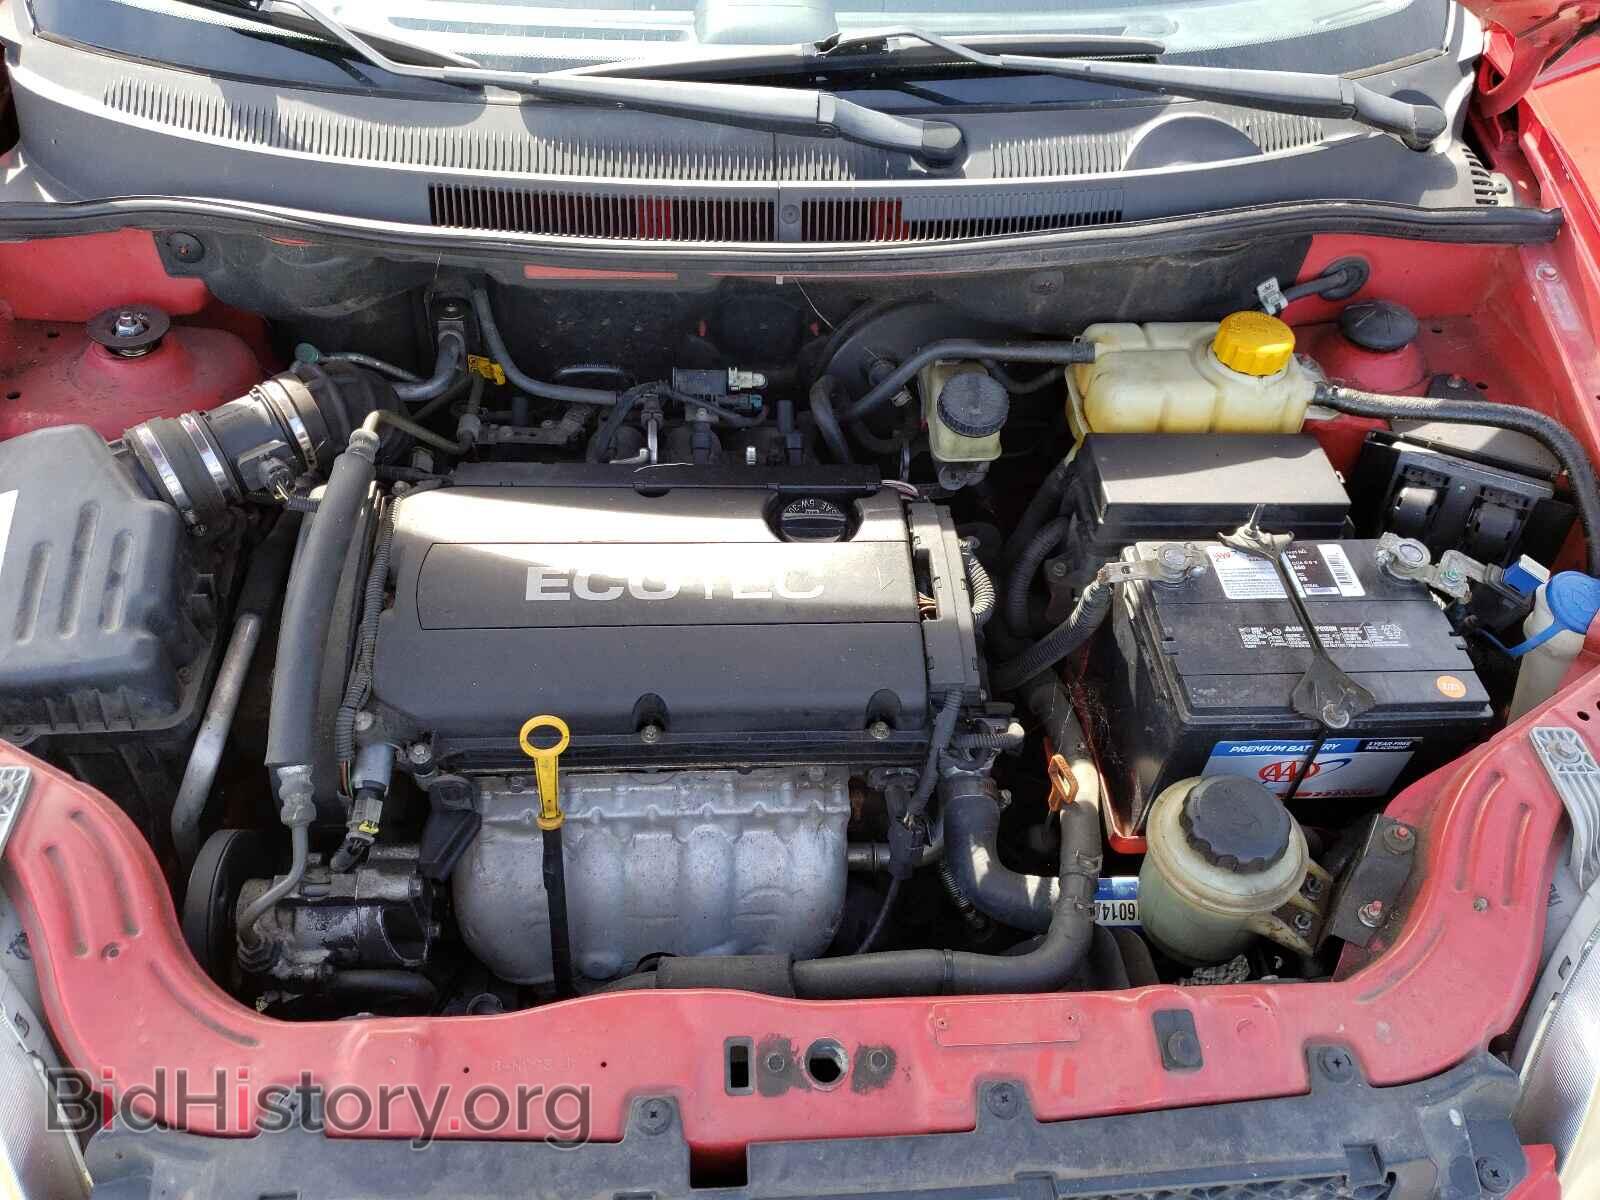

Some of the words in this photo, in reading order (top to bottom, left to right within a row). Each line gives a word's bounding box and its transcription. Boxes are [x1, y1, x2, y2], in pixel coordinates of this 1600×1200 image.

[525, 565, 825, 601] ECOTEC
[1229, 745, 1287, 753] PREMIUM
[1286, 743, 1341, 753] BATRY
[1102, 903, 1140, 921] 6014
